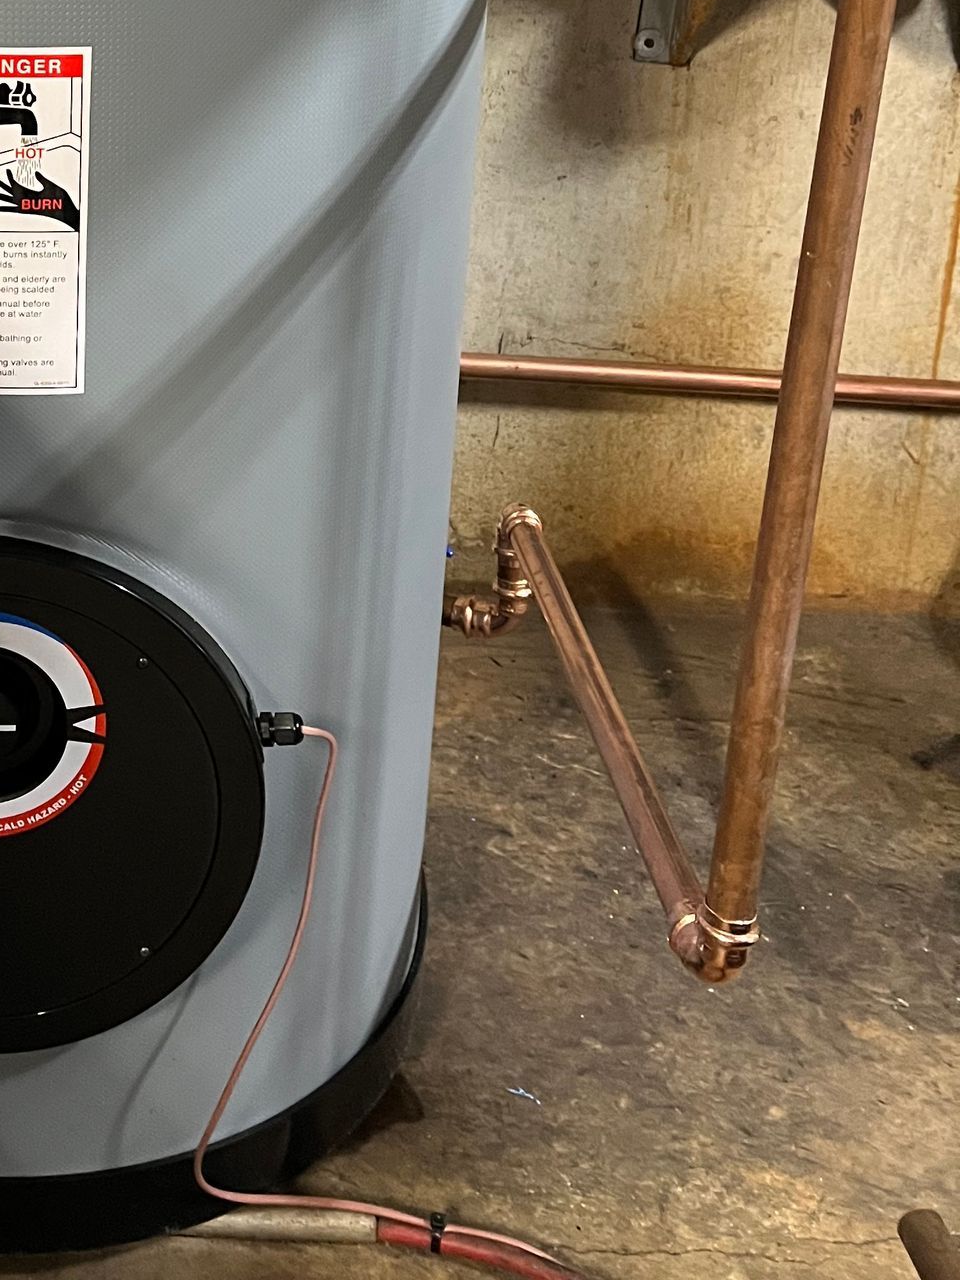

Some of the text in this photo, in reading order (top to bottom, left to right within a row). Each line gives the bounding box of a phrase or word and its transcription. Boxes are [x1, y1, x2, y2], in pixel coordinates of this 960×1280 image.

[15, 148, 45, 159] HOT
[21, 199, 62, 210] BURN
[4, 250, 28, 258] burns
[31, 251, 67, 260] instantly
[21, 276, 50, 285] elderly
[23, 300, 50, 308] before
[0, 334, 31, 344] bathing
[12, 358, 38, 366] valves
[26, 799, 67, 824] HAZARD
[70, 774, 88, 795] HOT
